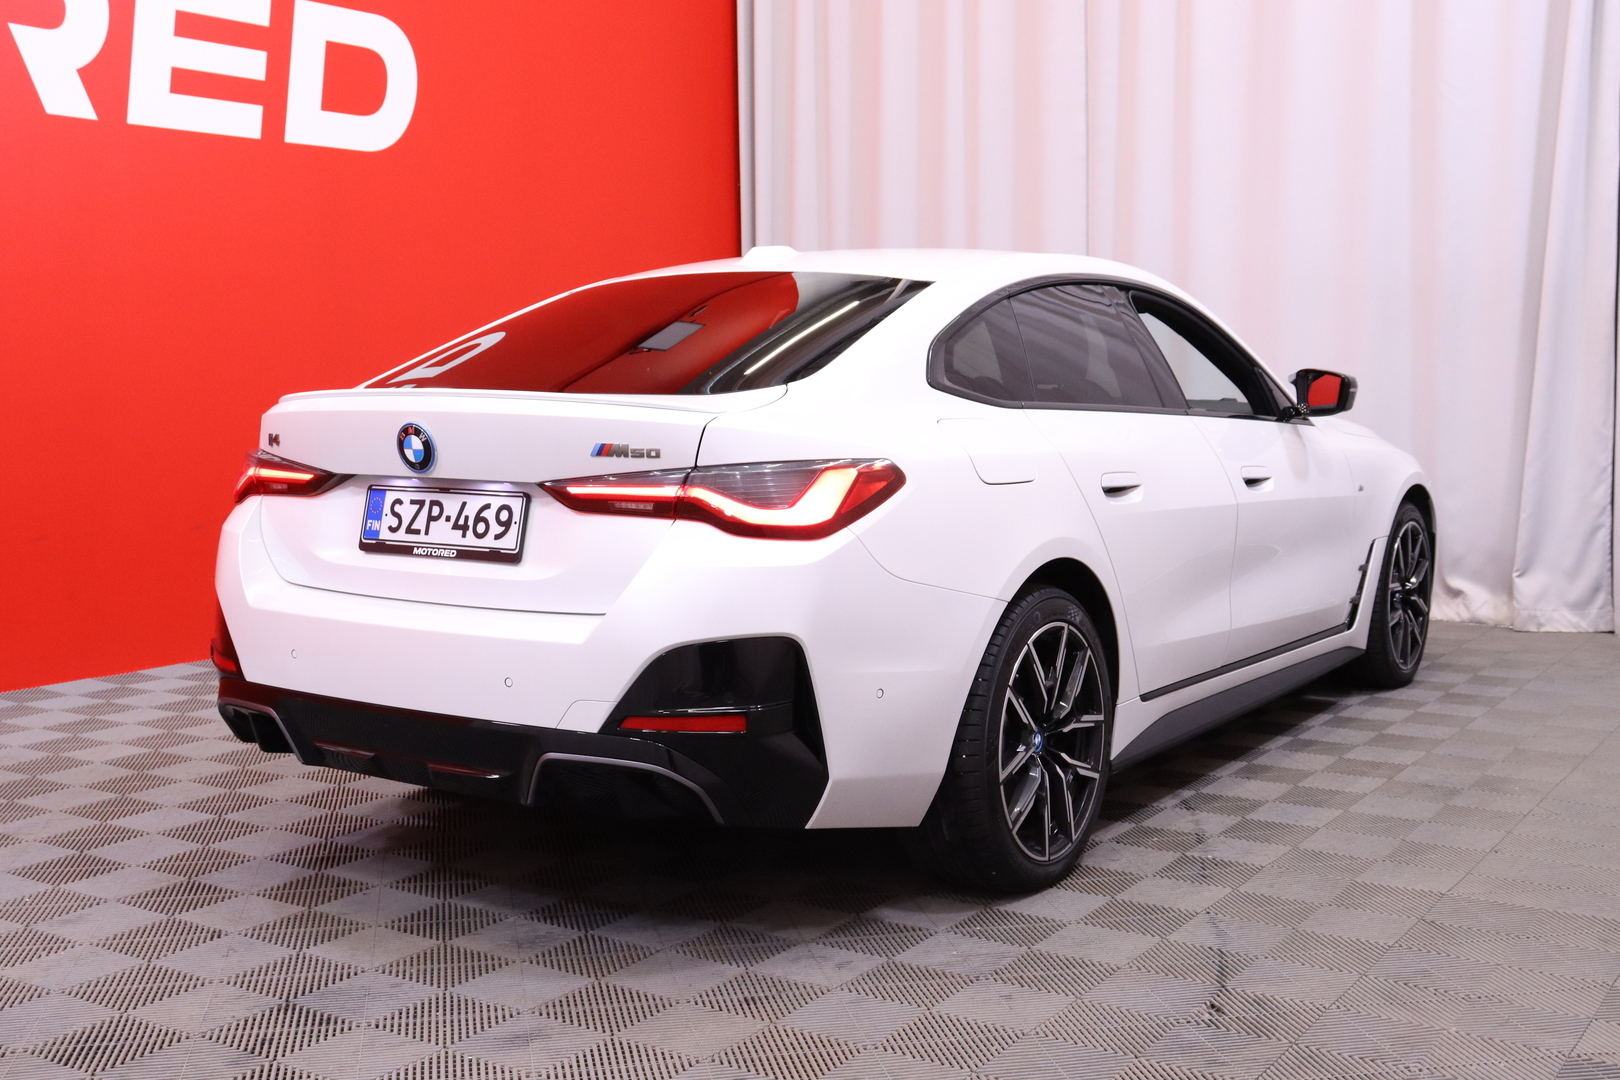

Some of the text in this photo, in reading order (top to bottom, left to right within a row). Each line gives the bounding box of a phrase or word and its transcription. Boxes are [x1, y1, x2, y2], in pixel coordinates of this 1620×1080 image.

[7, 0, 418, 152] RED
[400, 426, 427, 442] BMW
[605, 443, 661, 459] M50
[366, 520, 381, 531] FIN
[387, 497, 514, 541] SZP-469
[413, 547, 457, 558] MOTORED
